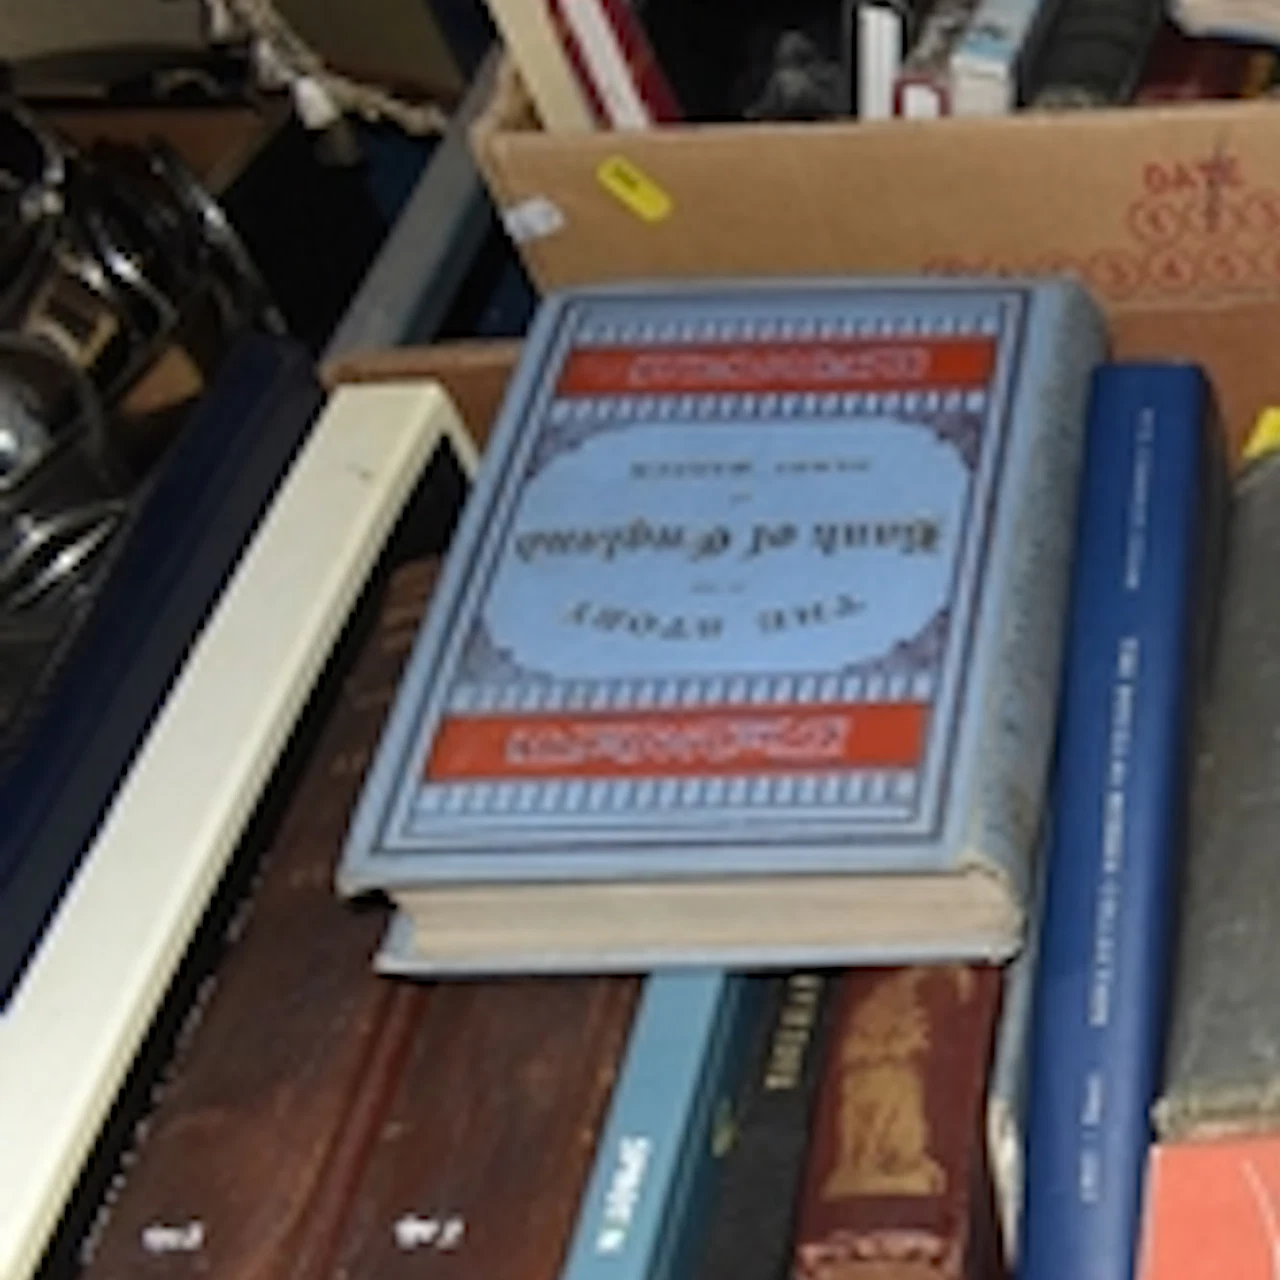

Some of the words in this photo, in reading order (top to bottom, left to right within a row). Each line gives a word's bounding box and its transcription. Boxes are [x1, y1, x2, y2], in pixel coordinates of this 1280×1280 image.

[514, 516, 734, 563] England
[744, 523, 799, 561] of
[811, 518, 940, 558] Bank
[560, 600, 725, 642] STORY
[757, 593, 866, 637] THE
